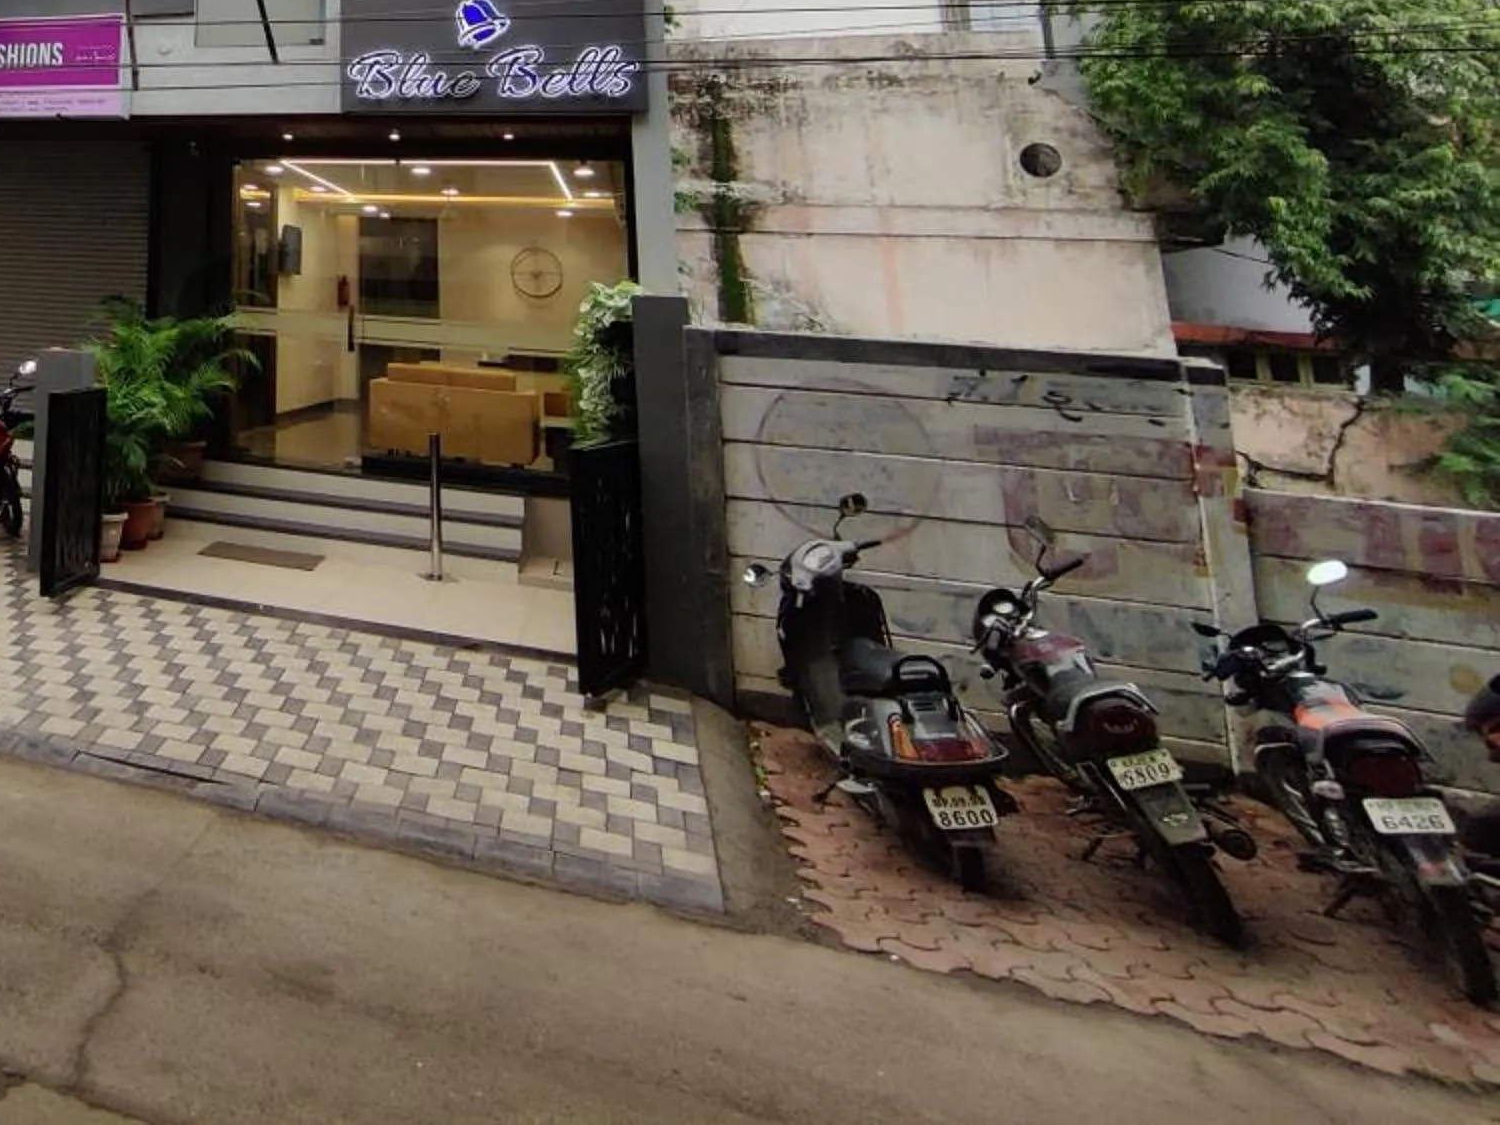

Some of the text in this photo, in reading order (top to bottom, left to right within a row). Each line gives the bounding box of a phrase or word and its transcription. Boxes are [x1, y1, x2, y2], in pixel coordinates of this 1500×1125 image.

[347, 44, 639, 99] Blue Bells
[938, 809, 994, 828] 8600
